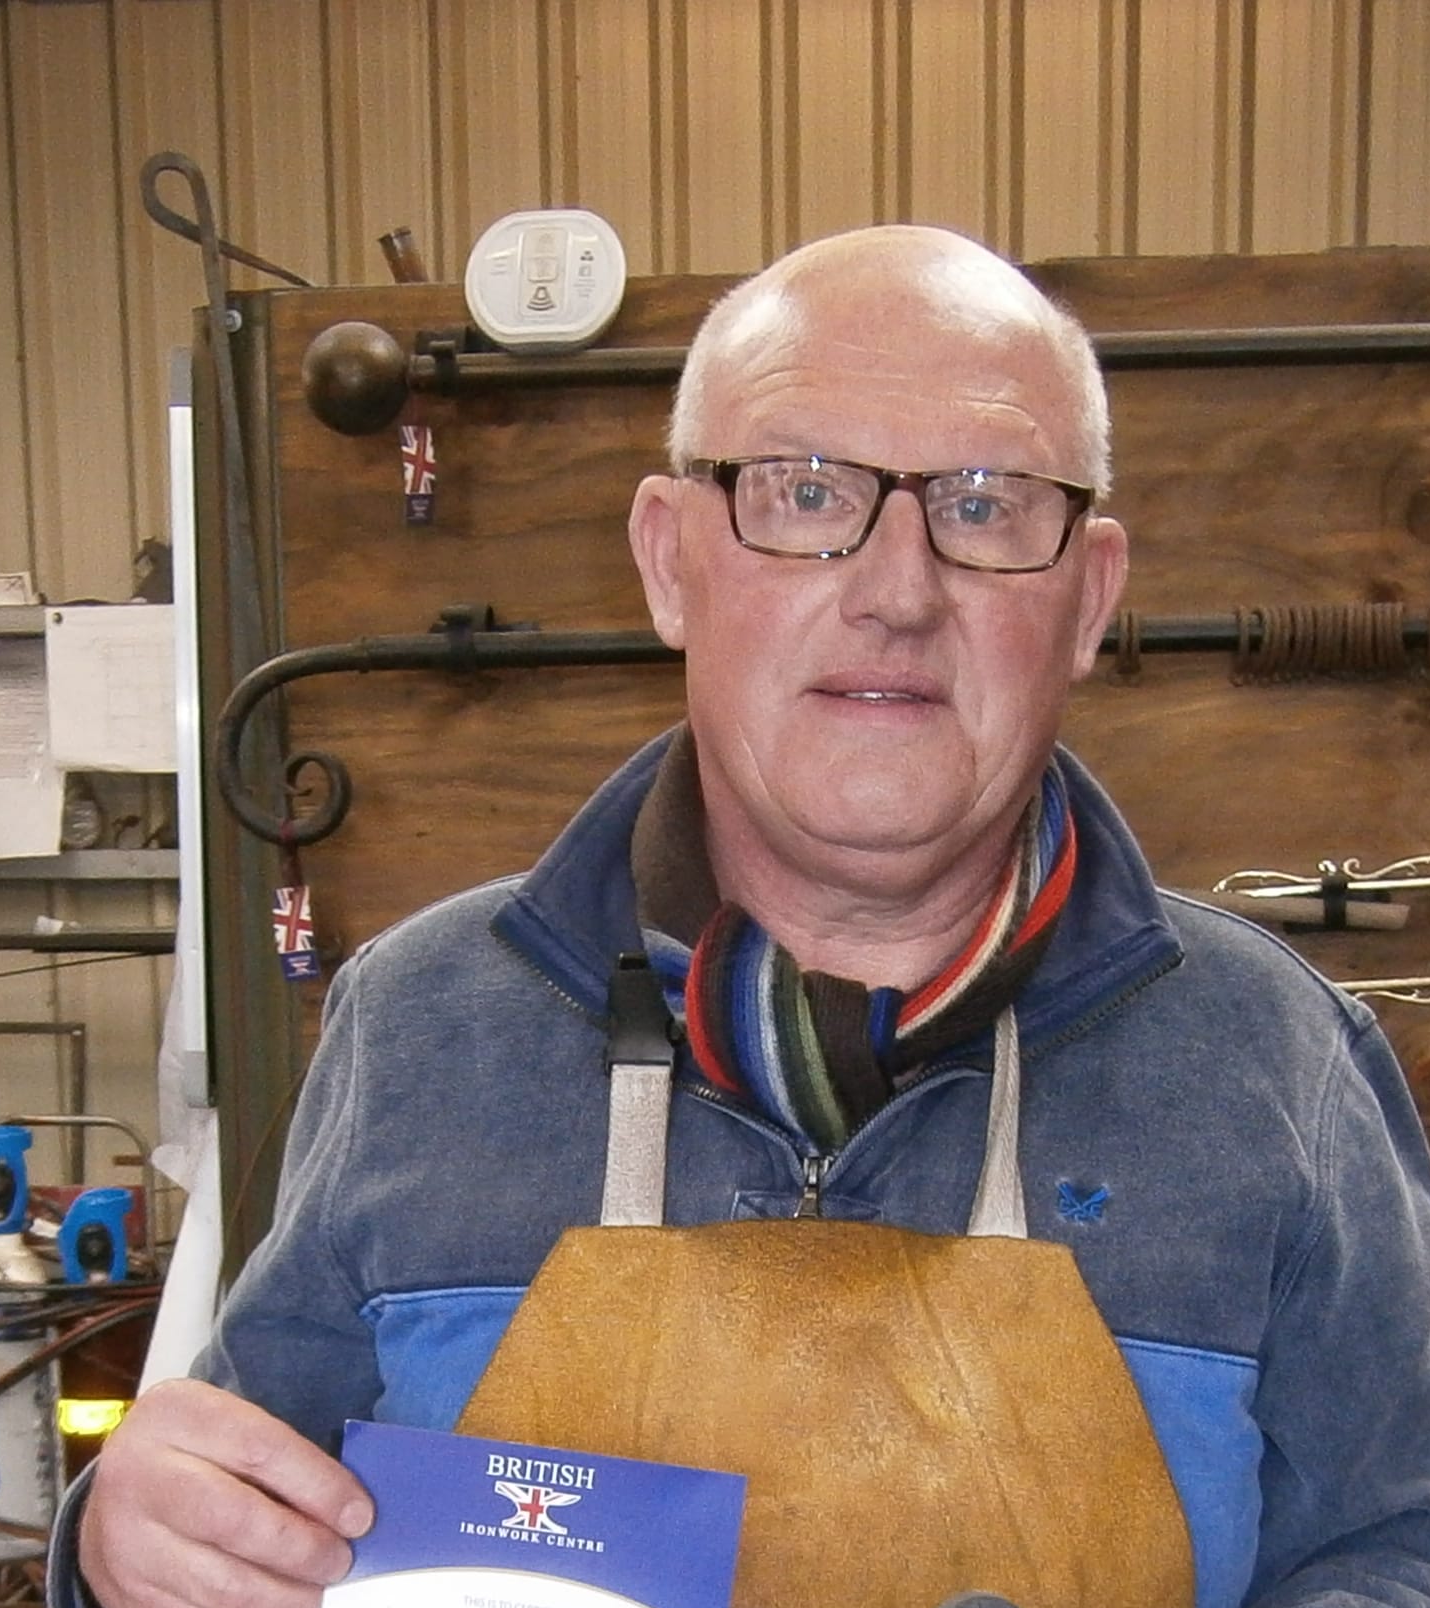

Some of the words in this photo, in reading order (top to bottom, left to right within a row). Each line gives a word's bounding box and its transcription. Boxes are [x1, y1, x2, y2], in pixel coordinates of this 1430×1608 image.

[486, 1454, 596, 1489] BRITISH
[460, 1522, 541, 1544] IRONWORK
[546, 1535, 605, 1553] CENTRE
[464, 1595, 486, 1608] THIS
